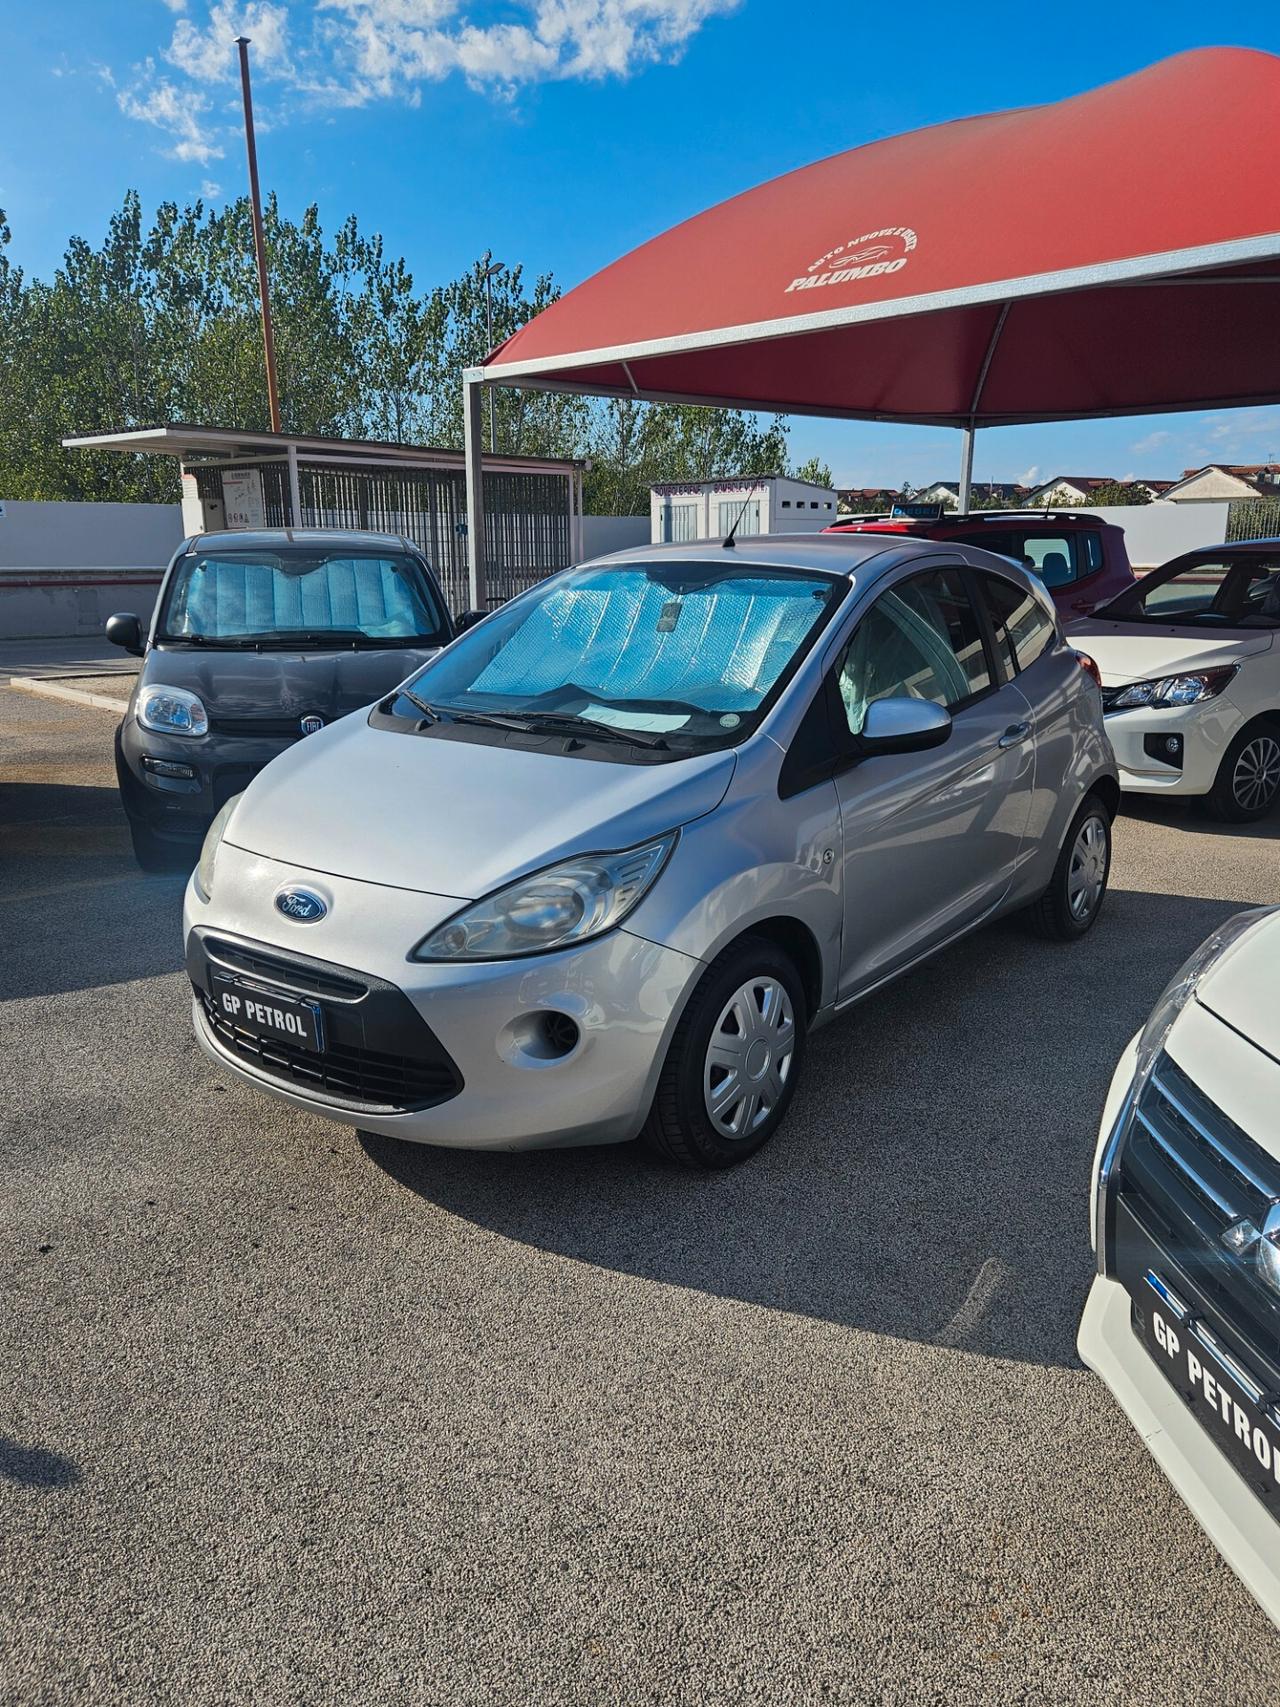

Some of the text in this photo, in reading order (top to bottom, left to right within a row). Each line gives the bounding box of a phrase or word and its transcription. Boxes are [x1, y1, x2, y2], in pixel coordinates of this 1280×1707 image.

[784, 258, 907, 293] PALUMBO
[306, 721, 320, 732] FIAT
[282, 894, 310, 918] Ford
[222, 993, 307, 1037] GP PETROL
[1152, 1311, 1180, 1359] GP
